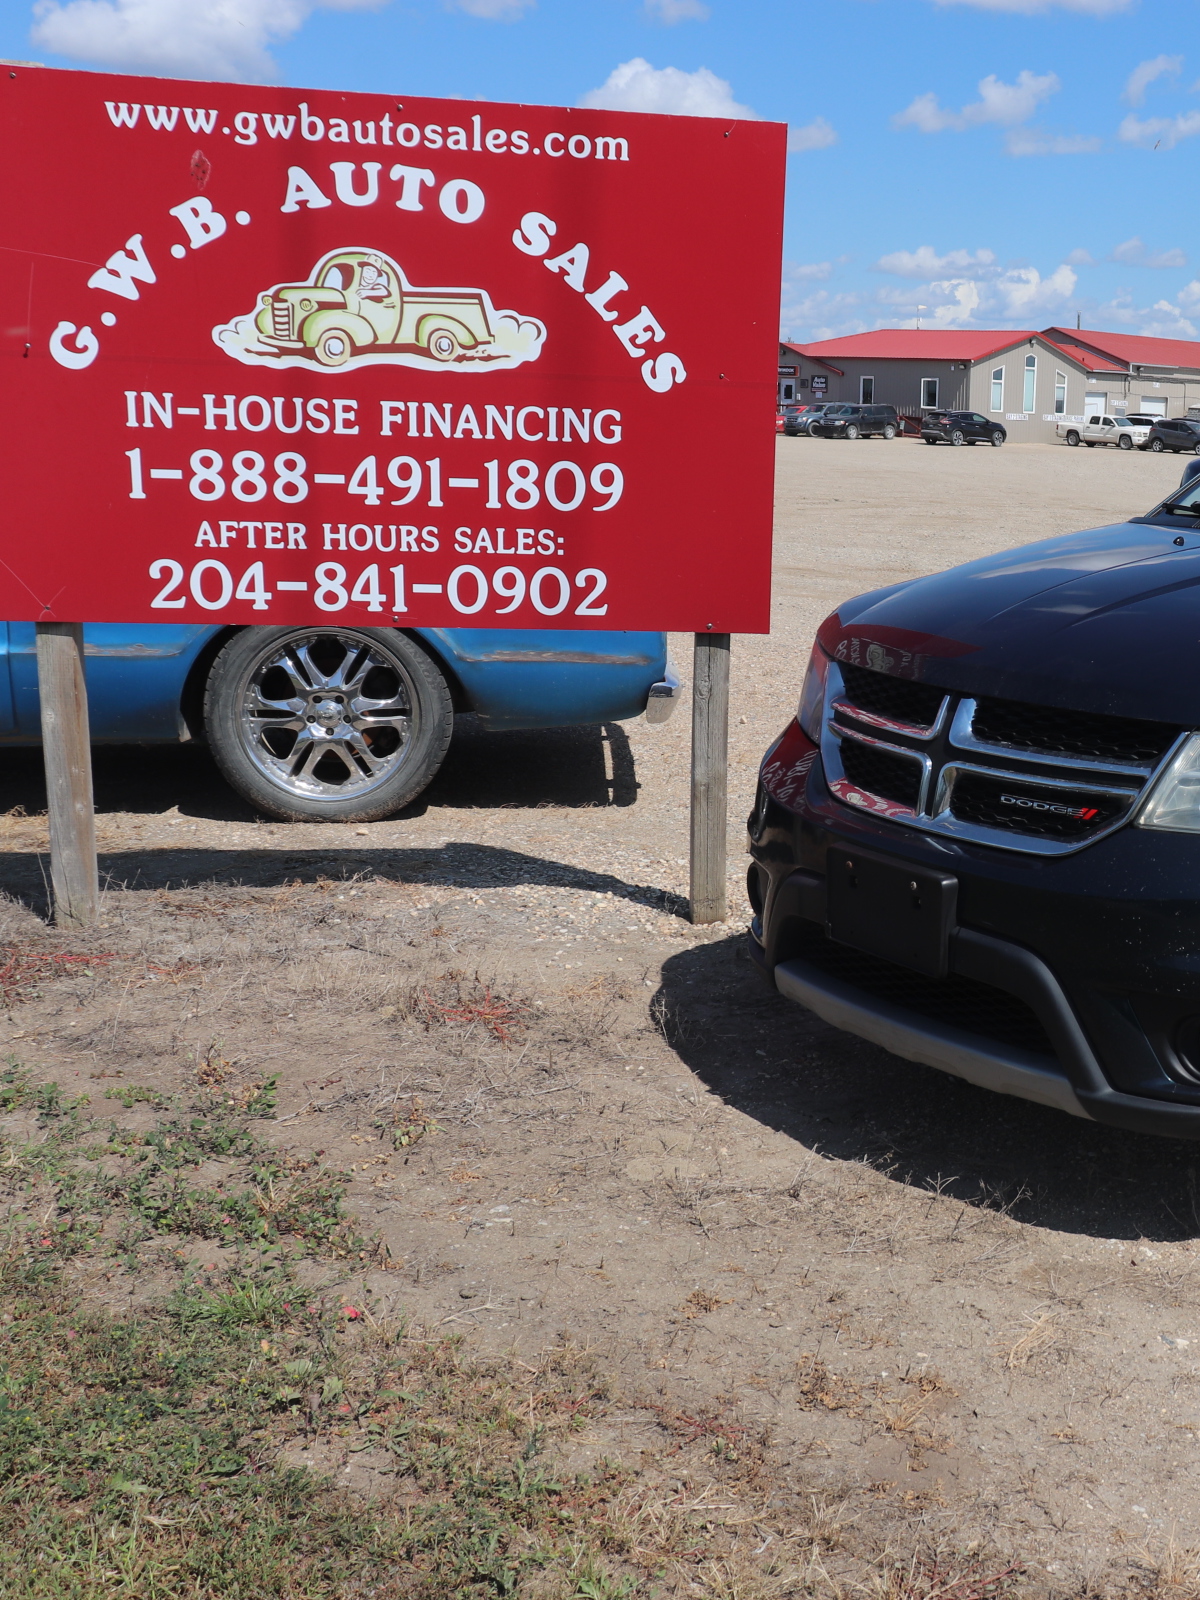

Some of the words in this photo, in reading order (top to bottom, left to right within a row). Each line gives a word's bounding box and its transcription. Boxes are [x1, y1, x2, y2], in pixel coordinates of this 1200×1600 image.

[104, 101, 630, 161] www.gwbautosales.com
[49, 196, 251, 370] G.W.B.
[280, 161, 486, 224] AUTO
[512, 211, 687, 393] SALES
[124, 390, 359, 435] IN-HOUSE
[379, 400, 623, 445] FINANCING
[124, 447, 624, 512] 1-888-491-1809
[194, 520, 308, 551] AFTER
[322, 523, 440, 553] HOURS
[454, 526, 566, 556] SALES:
[149, 558, 608, 616] 204-841-0902
[1000, 795, 1085, 818] DODGE
